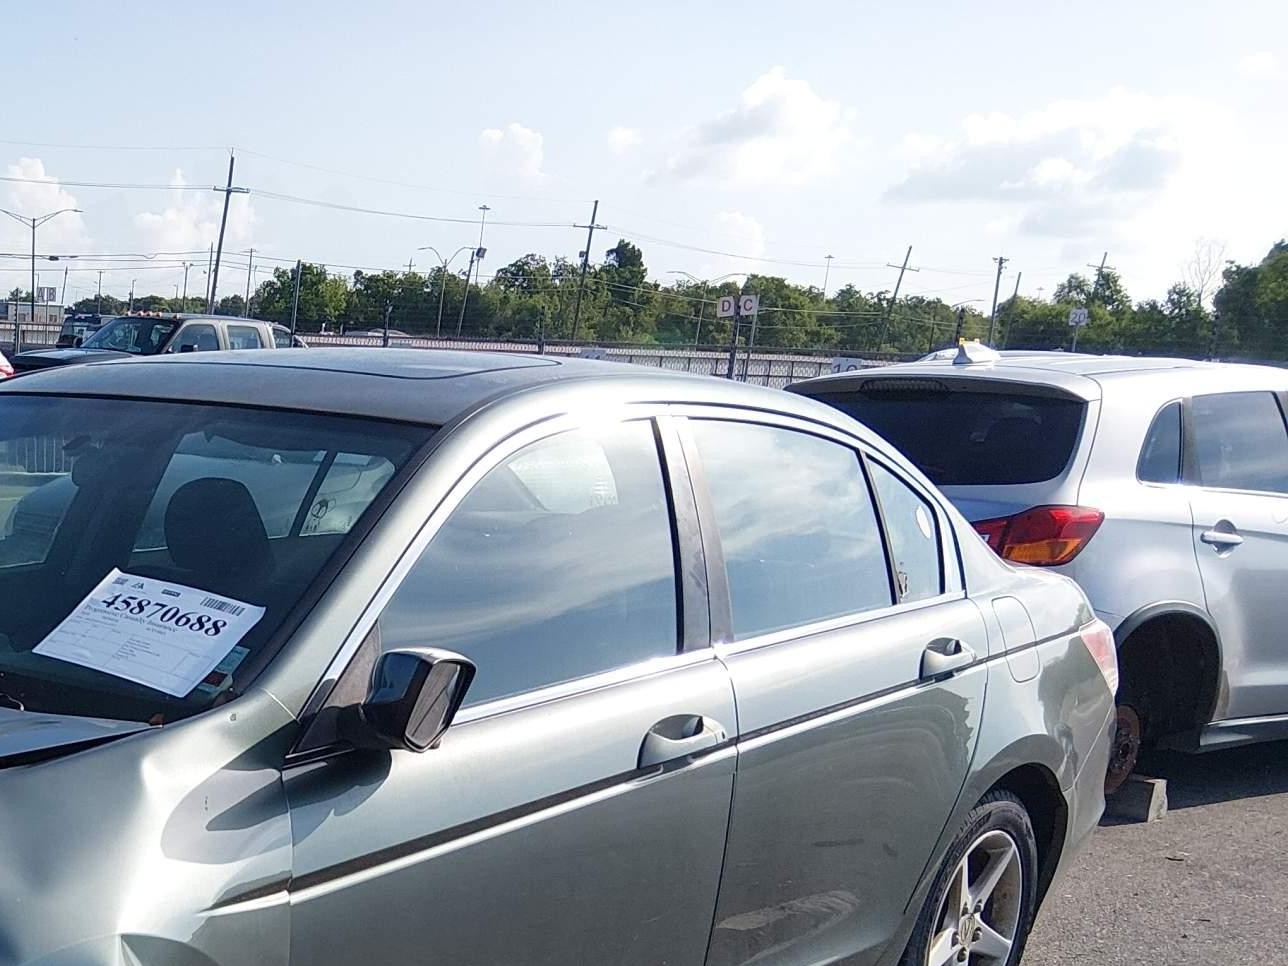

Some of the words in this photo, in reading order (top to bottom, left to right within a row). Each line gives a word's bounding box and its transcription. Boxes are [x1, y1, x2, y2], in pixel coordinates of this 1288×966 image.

[722, 300, 731, 312] D
[744, 299, 753, 311] C
[1072, 312, 1086, 324] 20
[102, 593, 227, 637] 45870688
